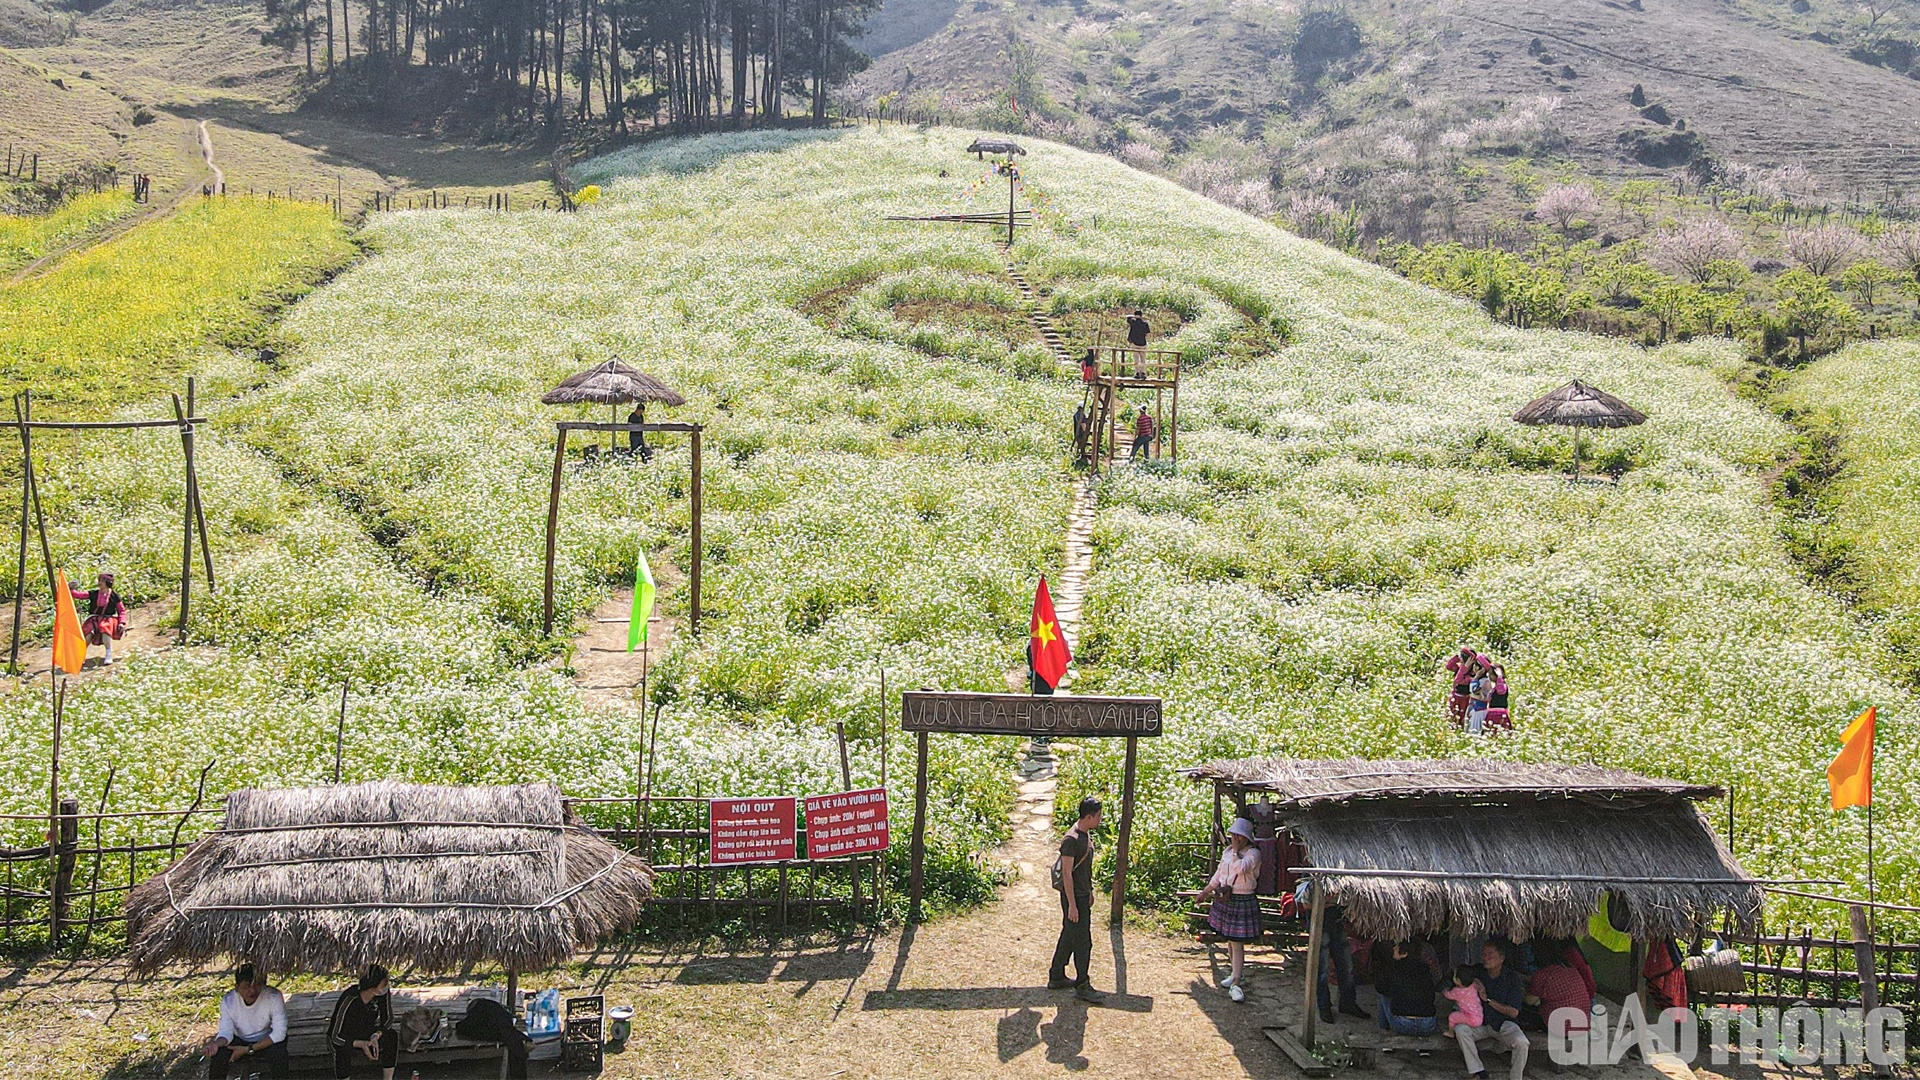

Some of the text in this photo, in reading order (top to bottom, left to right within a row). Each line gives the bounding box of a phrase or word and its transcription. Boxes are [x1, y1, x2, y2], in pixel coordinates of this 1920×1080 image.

[968, 700, 1010, 727] HOA
[732, 802, 775, 814] NỘI QUY
[832, 796, 847, 808] VÀO
[870, 792, 885, 802] HOA
